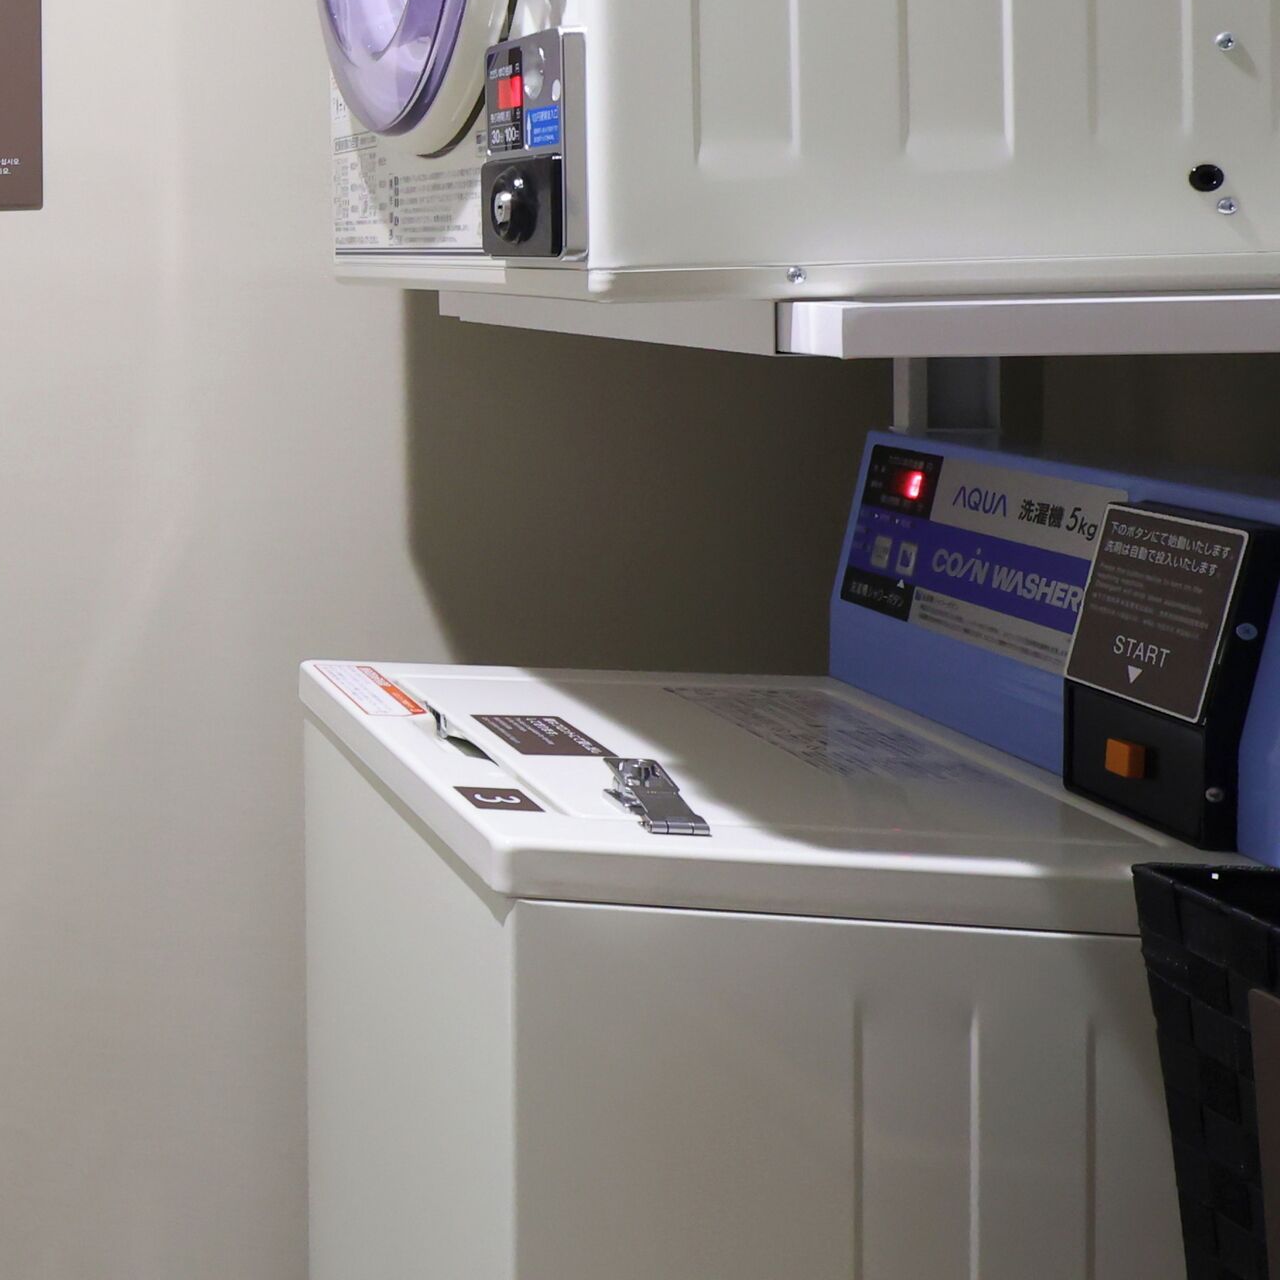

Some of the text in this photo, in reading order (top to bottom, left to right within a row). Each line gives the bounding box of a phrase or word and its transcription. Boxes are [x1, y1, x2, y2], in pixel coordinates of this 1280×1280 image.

[952, 486, 1098, 541] AQUA 洗濯機 5kg
[932, 547, 989, 585] COIN
[992, 567, 1084, 612] WASHER
[1113, 635, 1171, 667] START
[474, 793, 522, 804] 3
